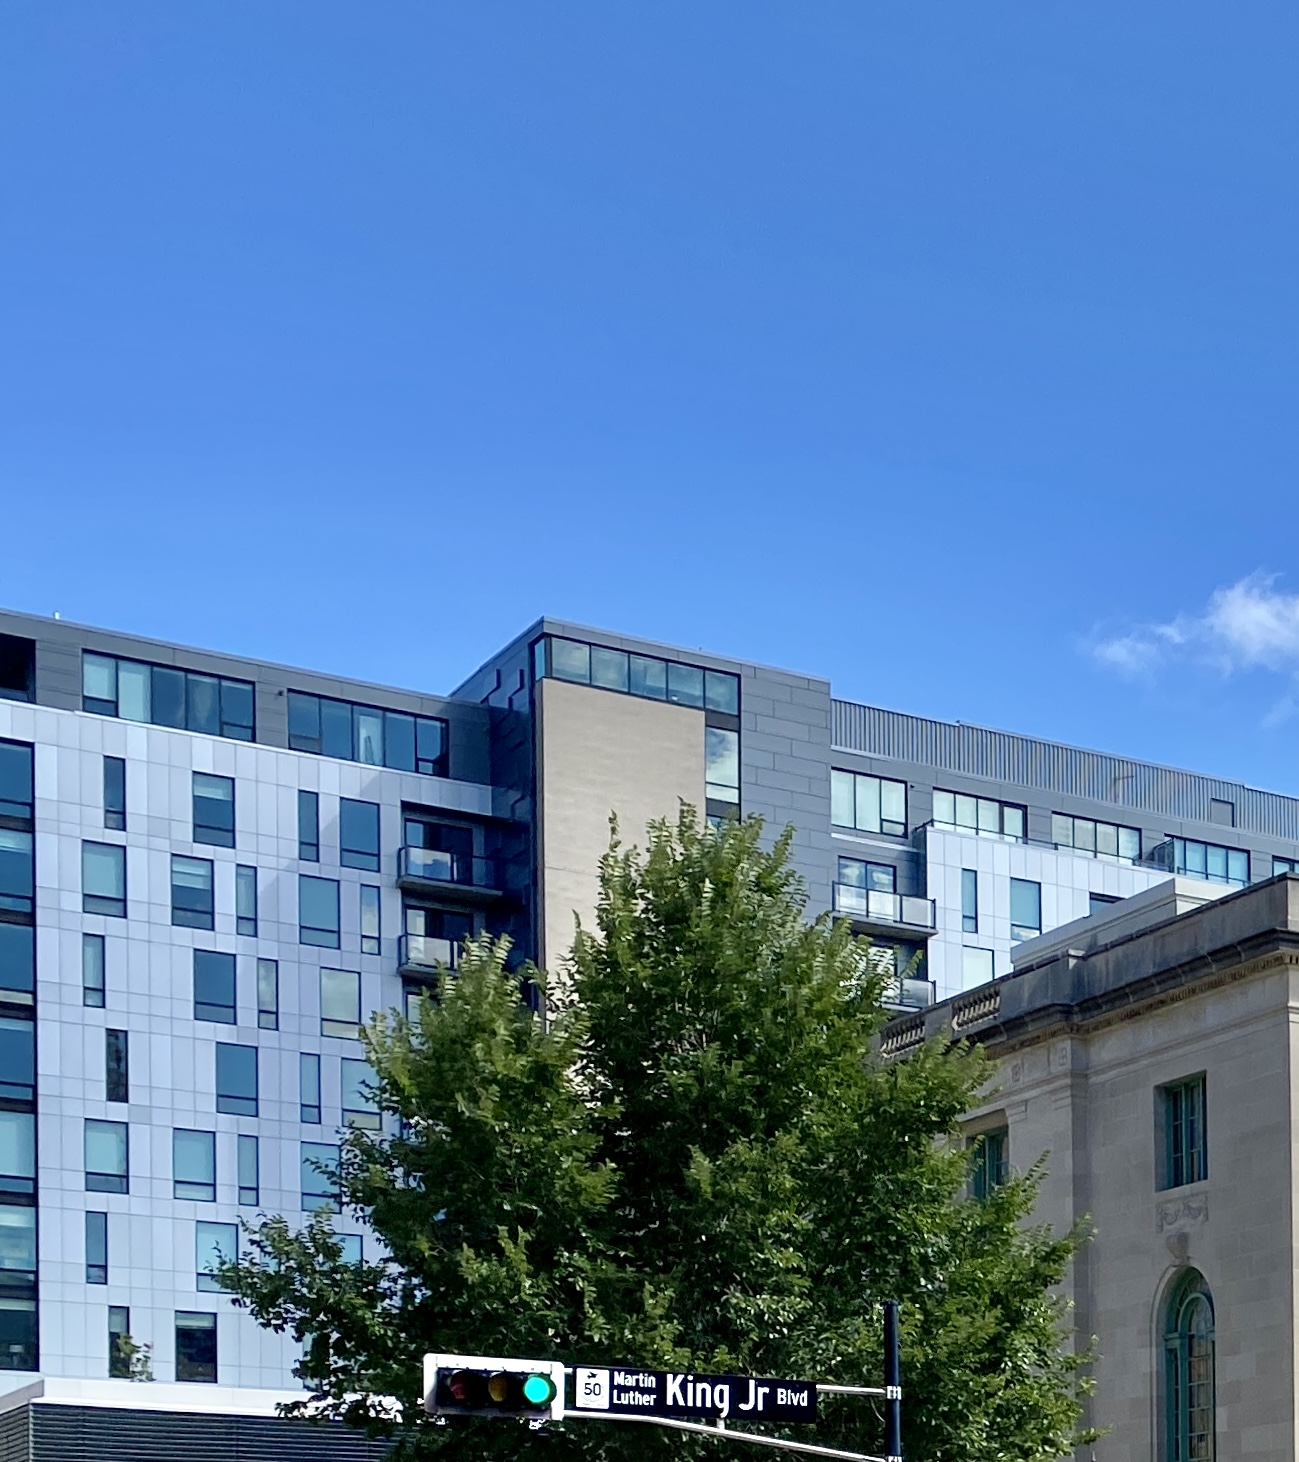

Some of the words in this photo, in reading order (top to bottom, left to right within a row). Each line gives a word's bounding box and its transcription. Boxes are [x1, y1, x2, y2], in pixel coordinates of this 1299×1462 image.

[613, 1371, 656, 1388] Martin
[584, 1382, 601, 1396] 50
[612, 1389, 657, 1406] Luther
[666, 1373, 730, 1418] King
[738, 1379, 770, 1411] Jr
[777, 1388, 808, 1407] Blvd
